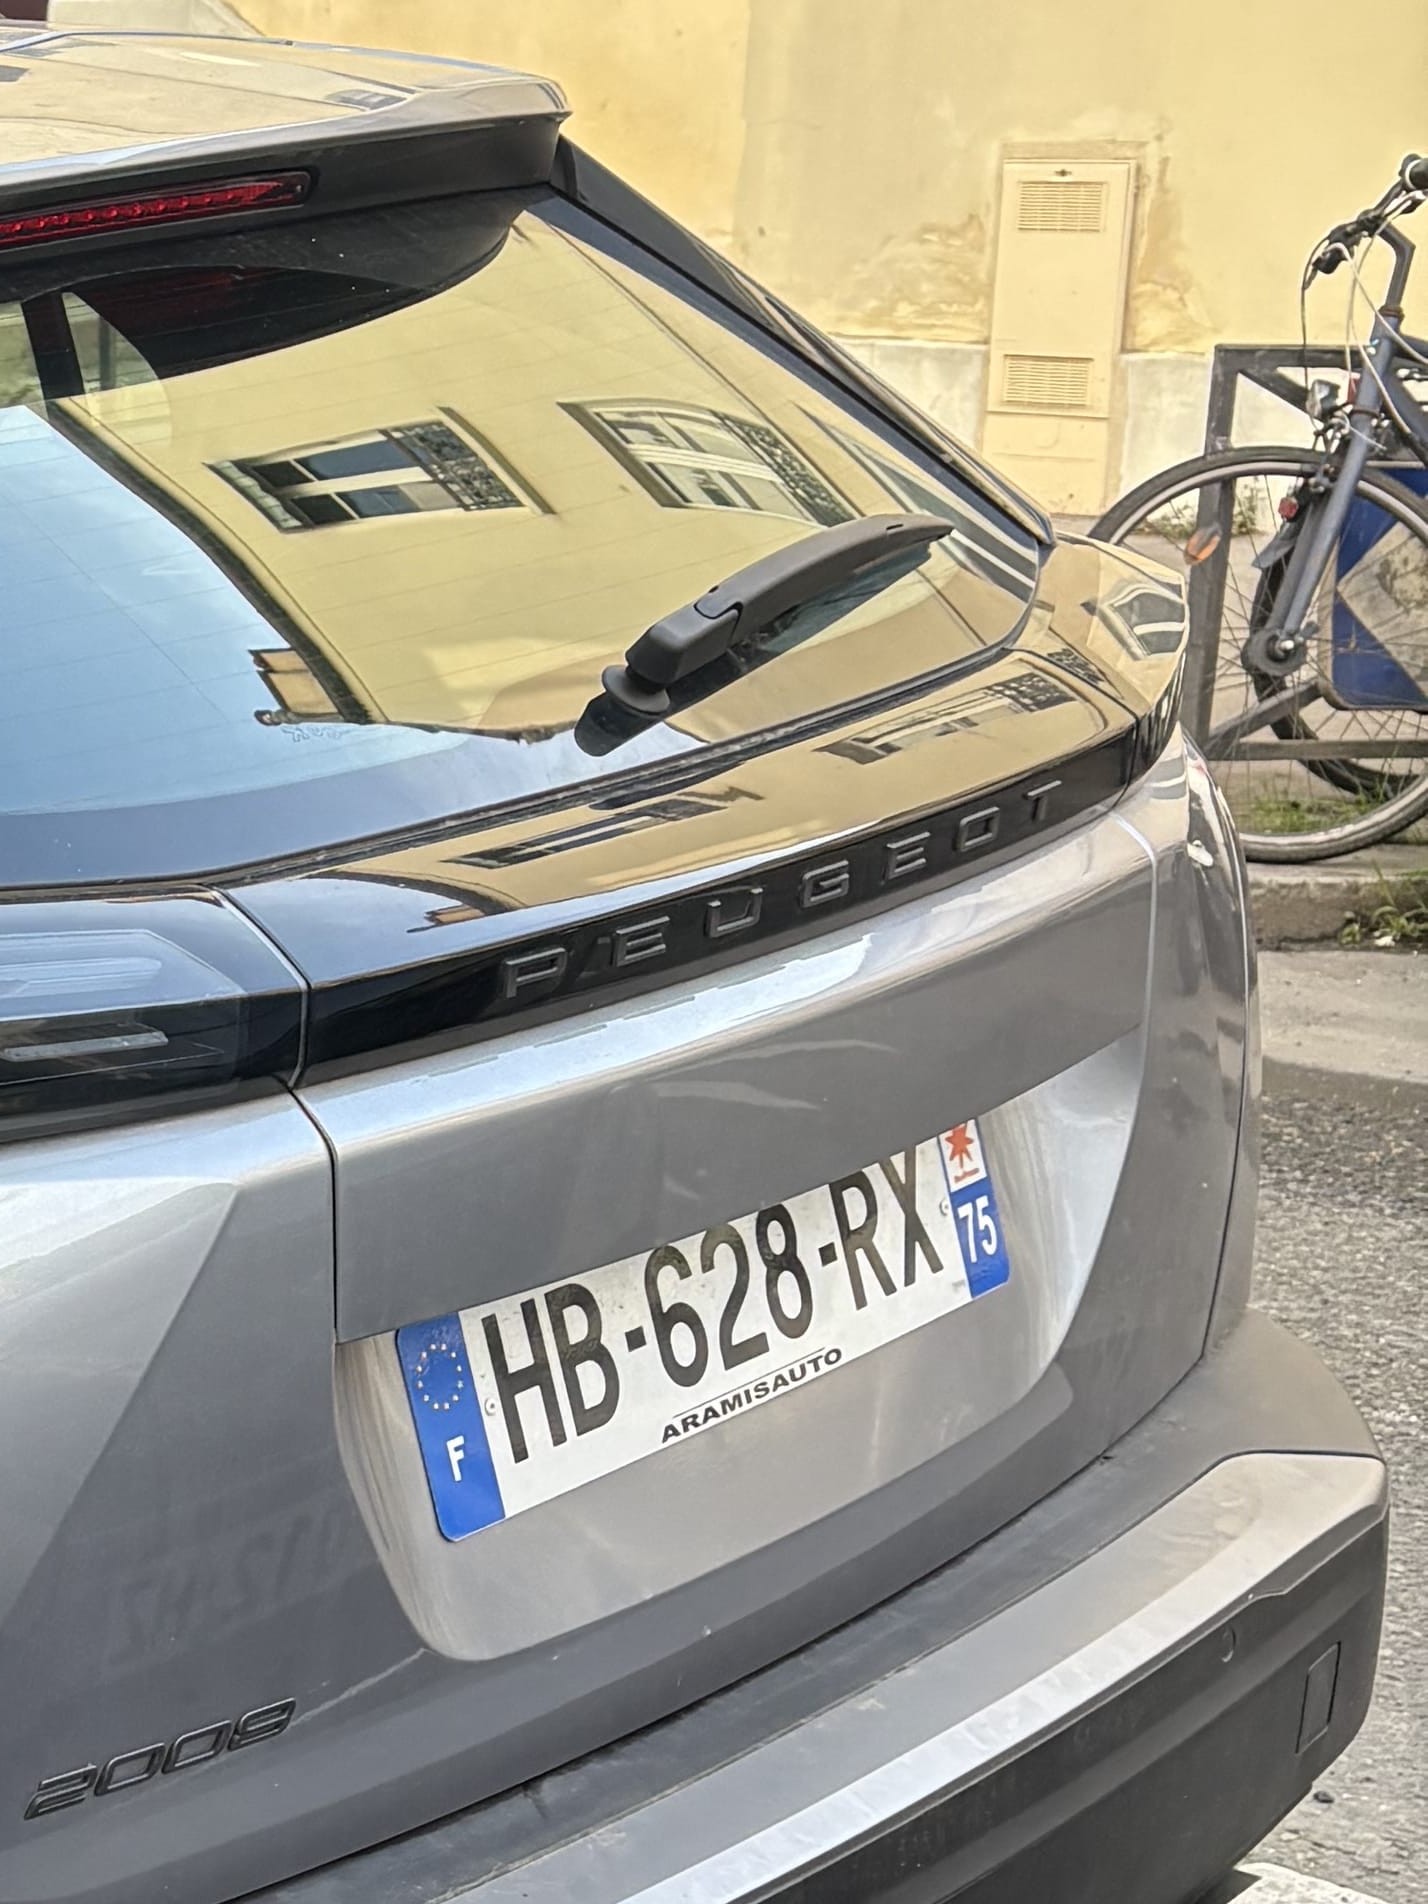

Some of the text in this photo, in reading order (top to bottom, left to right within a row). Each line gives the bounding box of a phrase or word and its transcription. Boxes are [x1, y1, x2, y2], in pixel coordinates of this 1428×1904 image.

[504, 779, 1063, 998] PEUGEOT
[957, 1195, 997, 1264] 75
[481, 1145, 945, 1464] HB-628-RX
[661, 1347, 843, 1444] ARAMISAUTO
[446, 1435, 465, 1482] F
[23, 1697, 297, 1821] 2008
